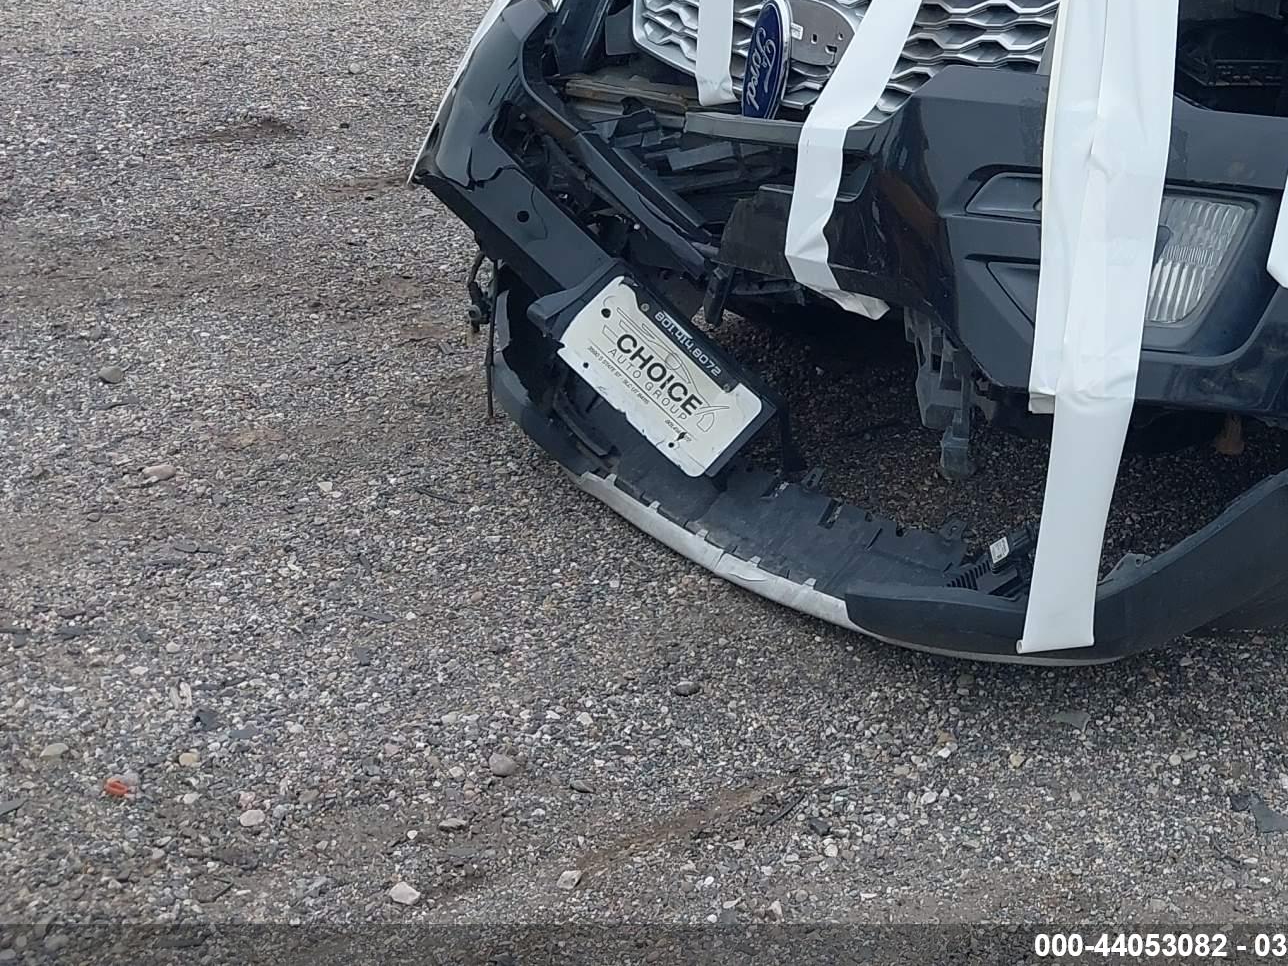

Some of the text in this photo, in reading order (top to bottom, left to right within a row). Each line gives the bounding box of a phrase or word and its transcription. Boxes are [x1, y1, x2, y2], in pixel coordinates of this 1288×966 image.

[746, 27, 777, 111] Ford
[616, 333, 704, 416] CHOICE
[654, 311, 722, 377] 801.414.8072
[608, 349, 688, 421] AUTO GROUP
